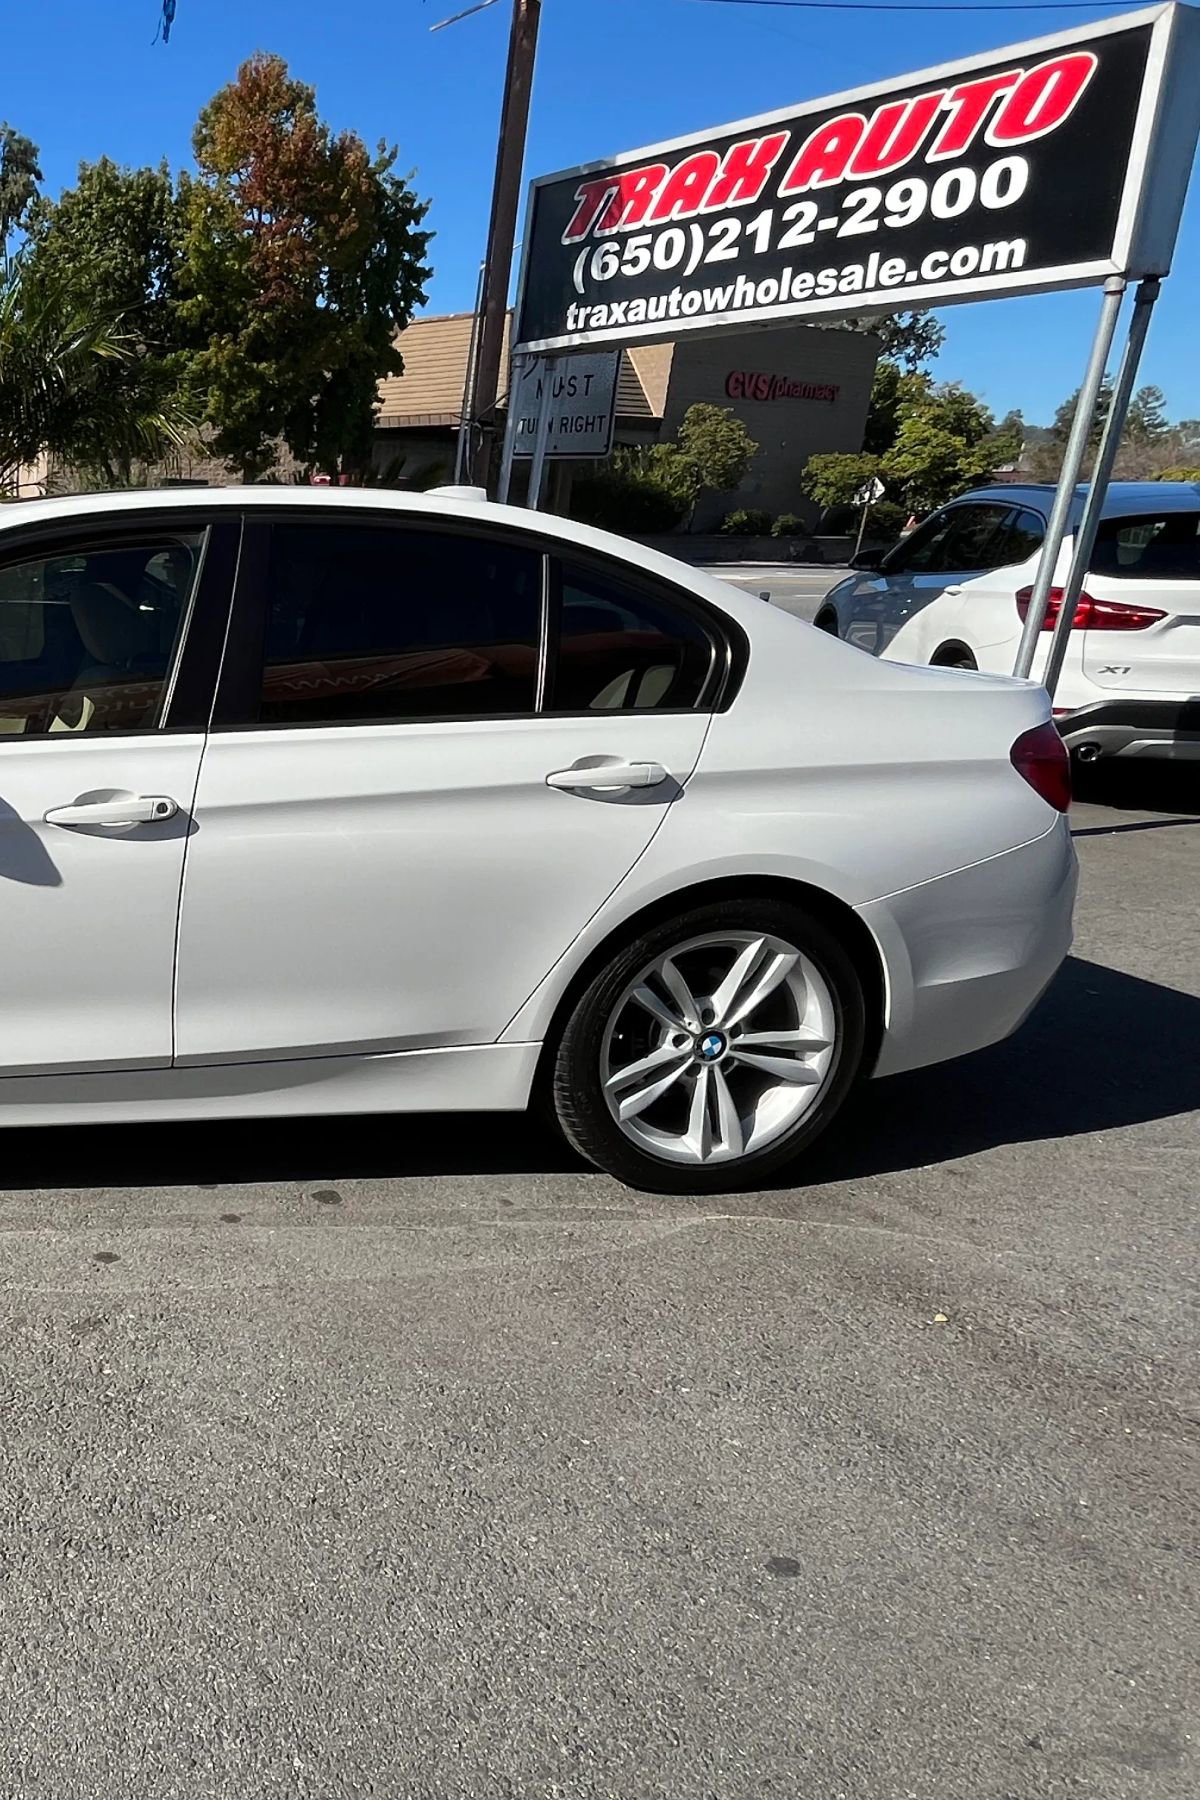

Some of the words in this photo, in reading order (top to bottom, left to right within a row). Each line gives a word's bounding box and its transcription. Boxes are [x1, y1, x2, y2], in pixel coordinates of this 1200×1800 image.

[561, 130, 792, 245] TRAX
[777, 51, 1098, 198] AUTO
[573, 155, 1029, 294] (650)212-2900
[566, 238, 1027, 330] traxautowholesale.com
[559, 415, 607, 434] RIGHT
[1096, 665, 1132, 674] X1
